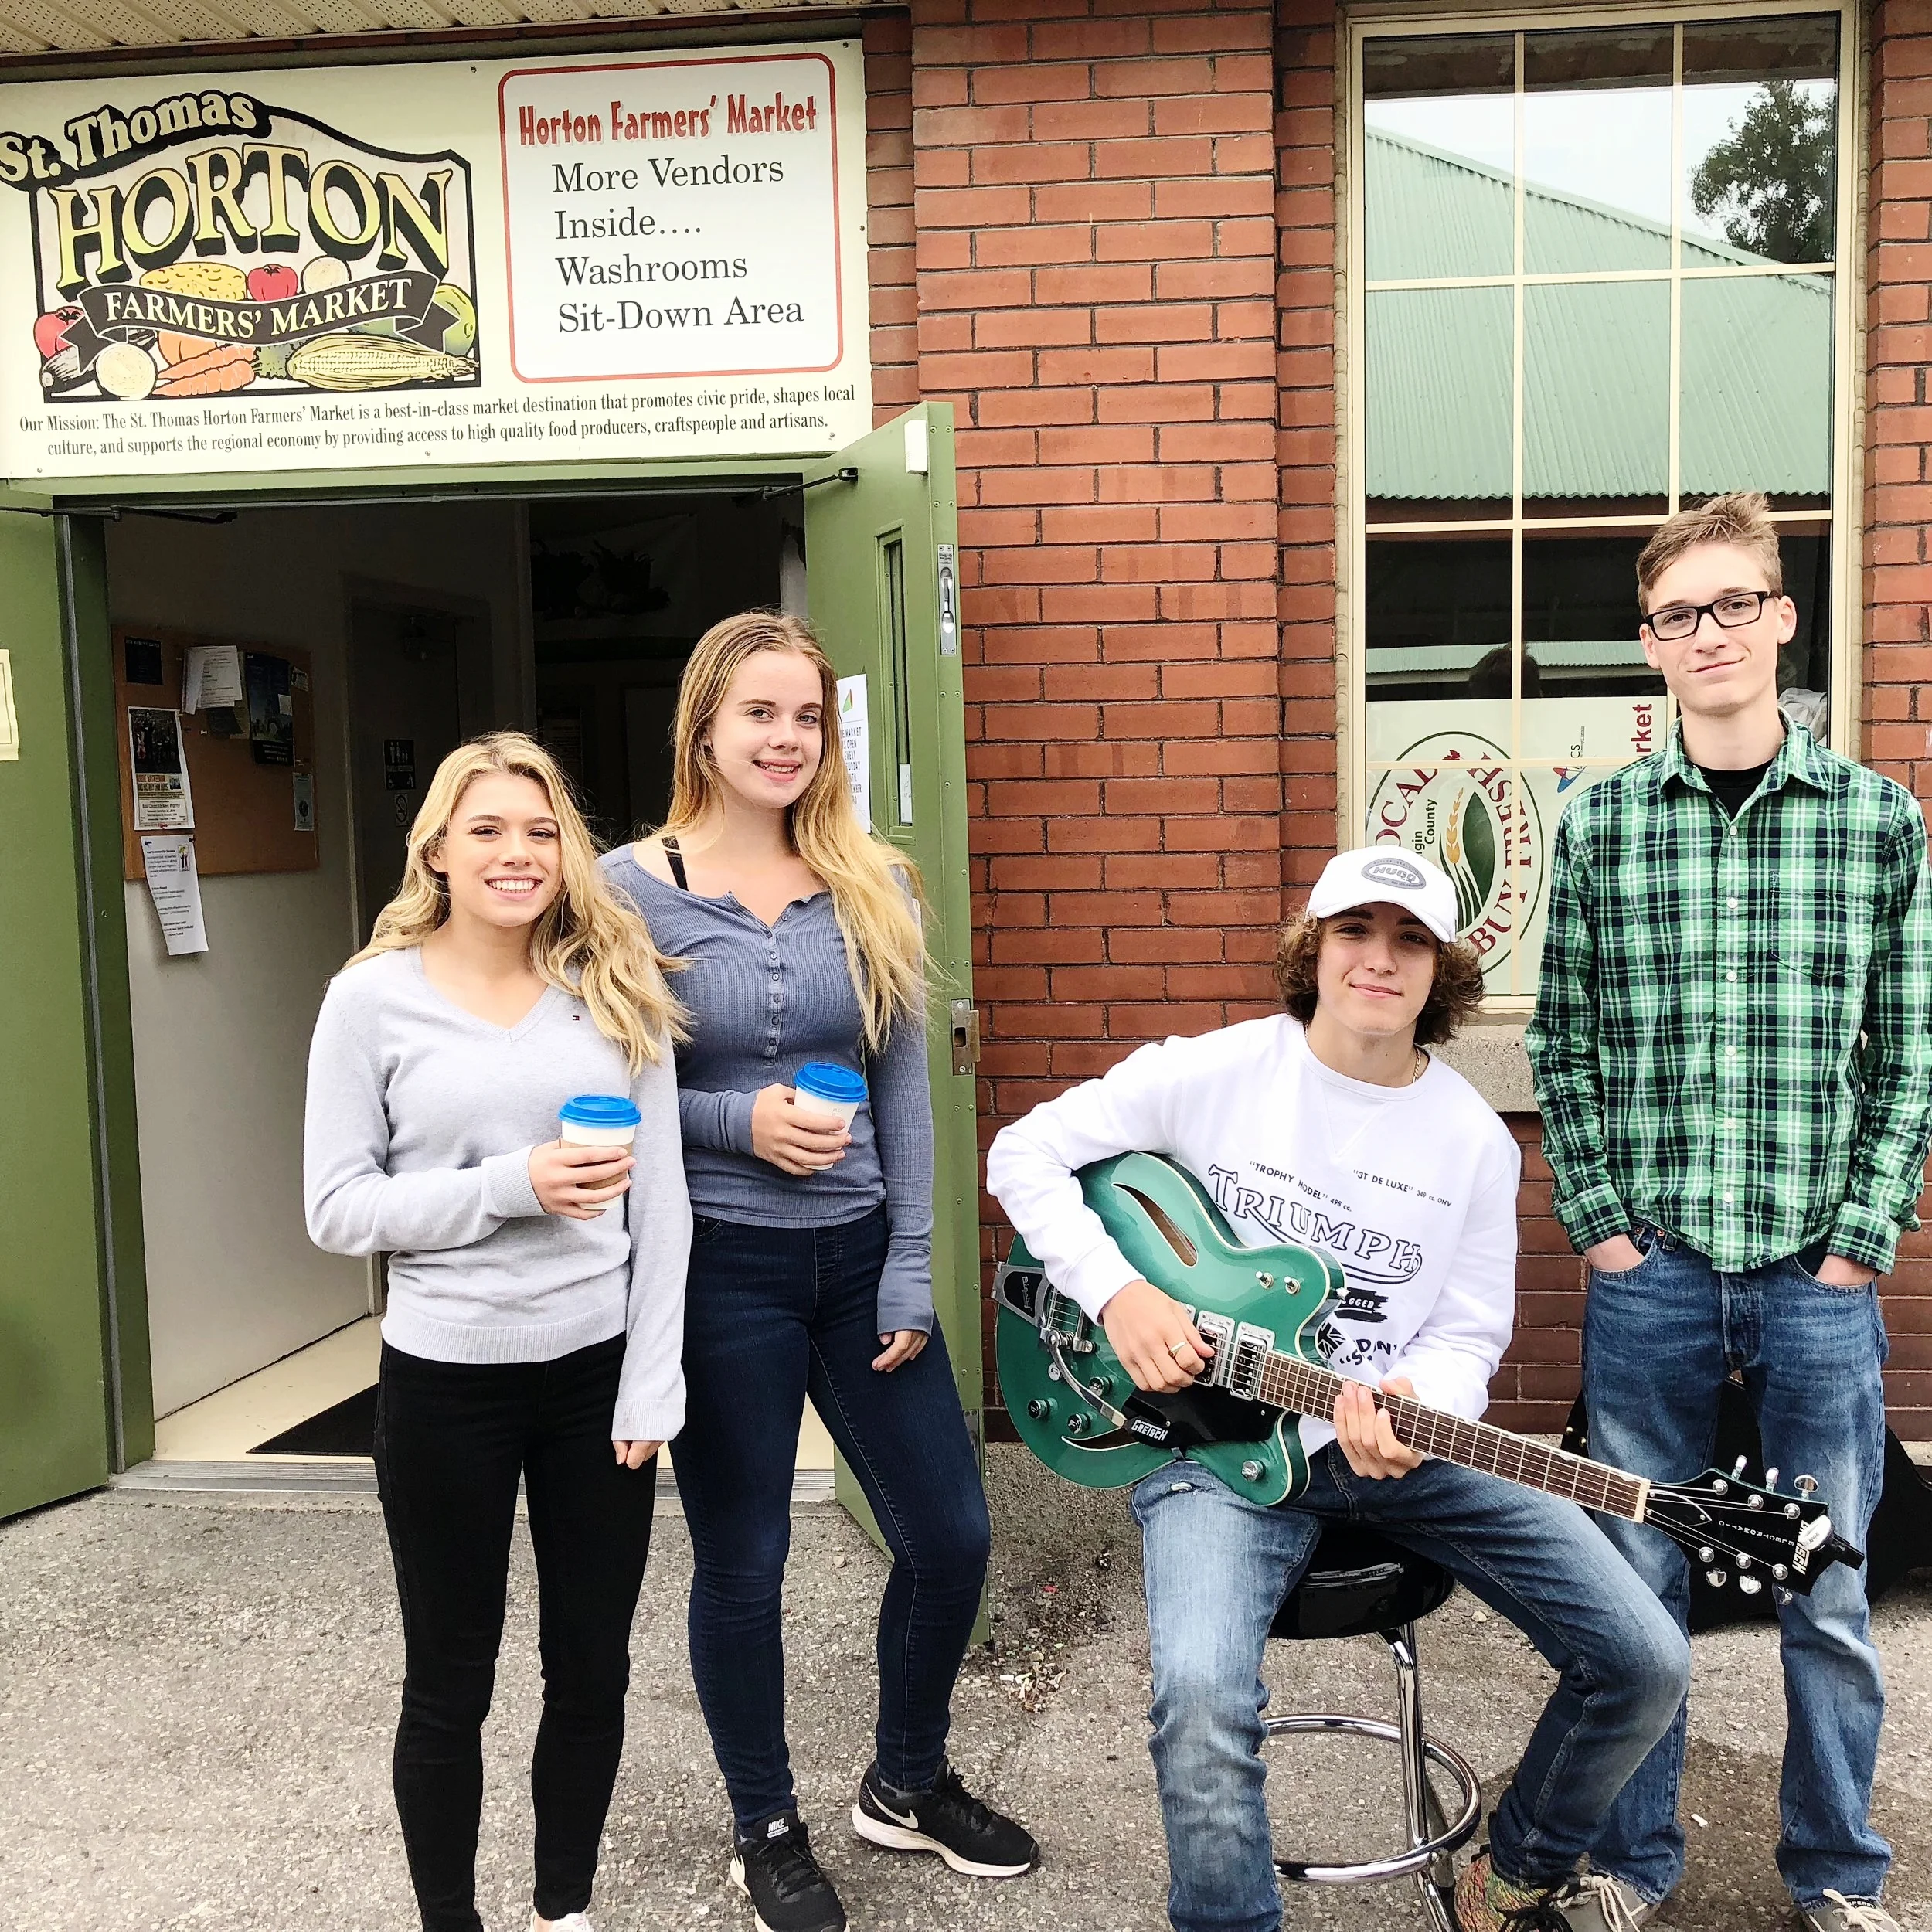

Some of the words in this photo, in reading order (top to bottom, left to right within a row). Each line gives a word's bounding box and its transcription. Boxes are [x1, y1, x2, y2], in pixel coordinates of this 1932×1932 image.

[0, 134, 62, 182] St.
[68, 93, 257, 167] Thomas
[519, 105, 602, 146] Horton
[610, 94, 717, 141] Farmers'
[726, 91, 818, 134] Market
[551, 162, 638, 193] More
[647, 154, 784, 188] Vendors
[48, 142, 454, 292] HORTON
[554, 206, 702, 240] Inside....
[554, 253, 747, 287] Washrooms
[104, 291, 262, 338] FARMERS'
[270, 277, 412, 335] MARKET
[558, 300, 714, 333] Sit-Down
[723, 295, 804, 325] Area
[19, 416, 44, 432] Our
[47, 414, 100, 431] Mission:
[102, 413, 127, 430] The
[130, 412, 148, 428] St.
[150, 411, 200, 428] Thomas
[202, 410, 247, 426] Horton
[250, 406, 306, 424] Farmers'
[310, 404, 355, 422] Market
[359, 403, 370, 420] is
[373, 407, 381, 419] a
[384, 400, 469, 419] best-in-class
[473, 397, 519, 415] market
[522, 394, 597, 413] destination
[600, 393, 628, 410] that
[631, 391, 693, 411] promotes
[696, 389, 726, 406] civic
[730, 387, 770, 408] pride,
[773, 386, 820, 406] shapes
[823, 384, 855, 402] local
[47, 439, 97, 457] culture,
[100, 437, 124, 454] and
[128, 437, 184, 457] supports
[187, 434, 208, 451] the
[211, 432, 263, 453] regional
[267, 433, 321, 449] economy
[325, 430, 339, 448] by
[342, 427, 404, 448] providing
[407, 429, 447, 443] access
[451, 424, 464, 440] to
[468, 423, 496, 443] high
[500, 422, 545, 442] quality
[549, 420, 577, 437] food
[580, 418, 651, 439] producers,
[655, 413, 736, 435] craftspeople
[740, 413, 765, 430] and
[769, 412, 828, 429] artisans.
[1631, 703, 1652, 757] rket
[1375, 768, 1438, 847] OCAL
[1424, 799, 1437, 845] County
[1411, 831, 1425, 855] lgin
[1330, 1198, 1342, 1207] 498
[1371, 1175, 1384, 1185] DE
[1416, 1189, 1427, 1198] 349
[1437, 1197, 1452, 1207] OHV
[1208, 1163, 1423, 1275] TRIUMPH
[1340, 1297, 1375, 1309] GGED
[1131, 1419, 1168, 1441] GRETSCH
[1718, 1519, 1795, 1546] ELECTROMATIC
[1791, 1519, 1810, 1575] GTSCH
[767, 1818, 785, 1832] NIKE
